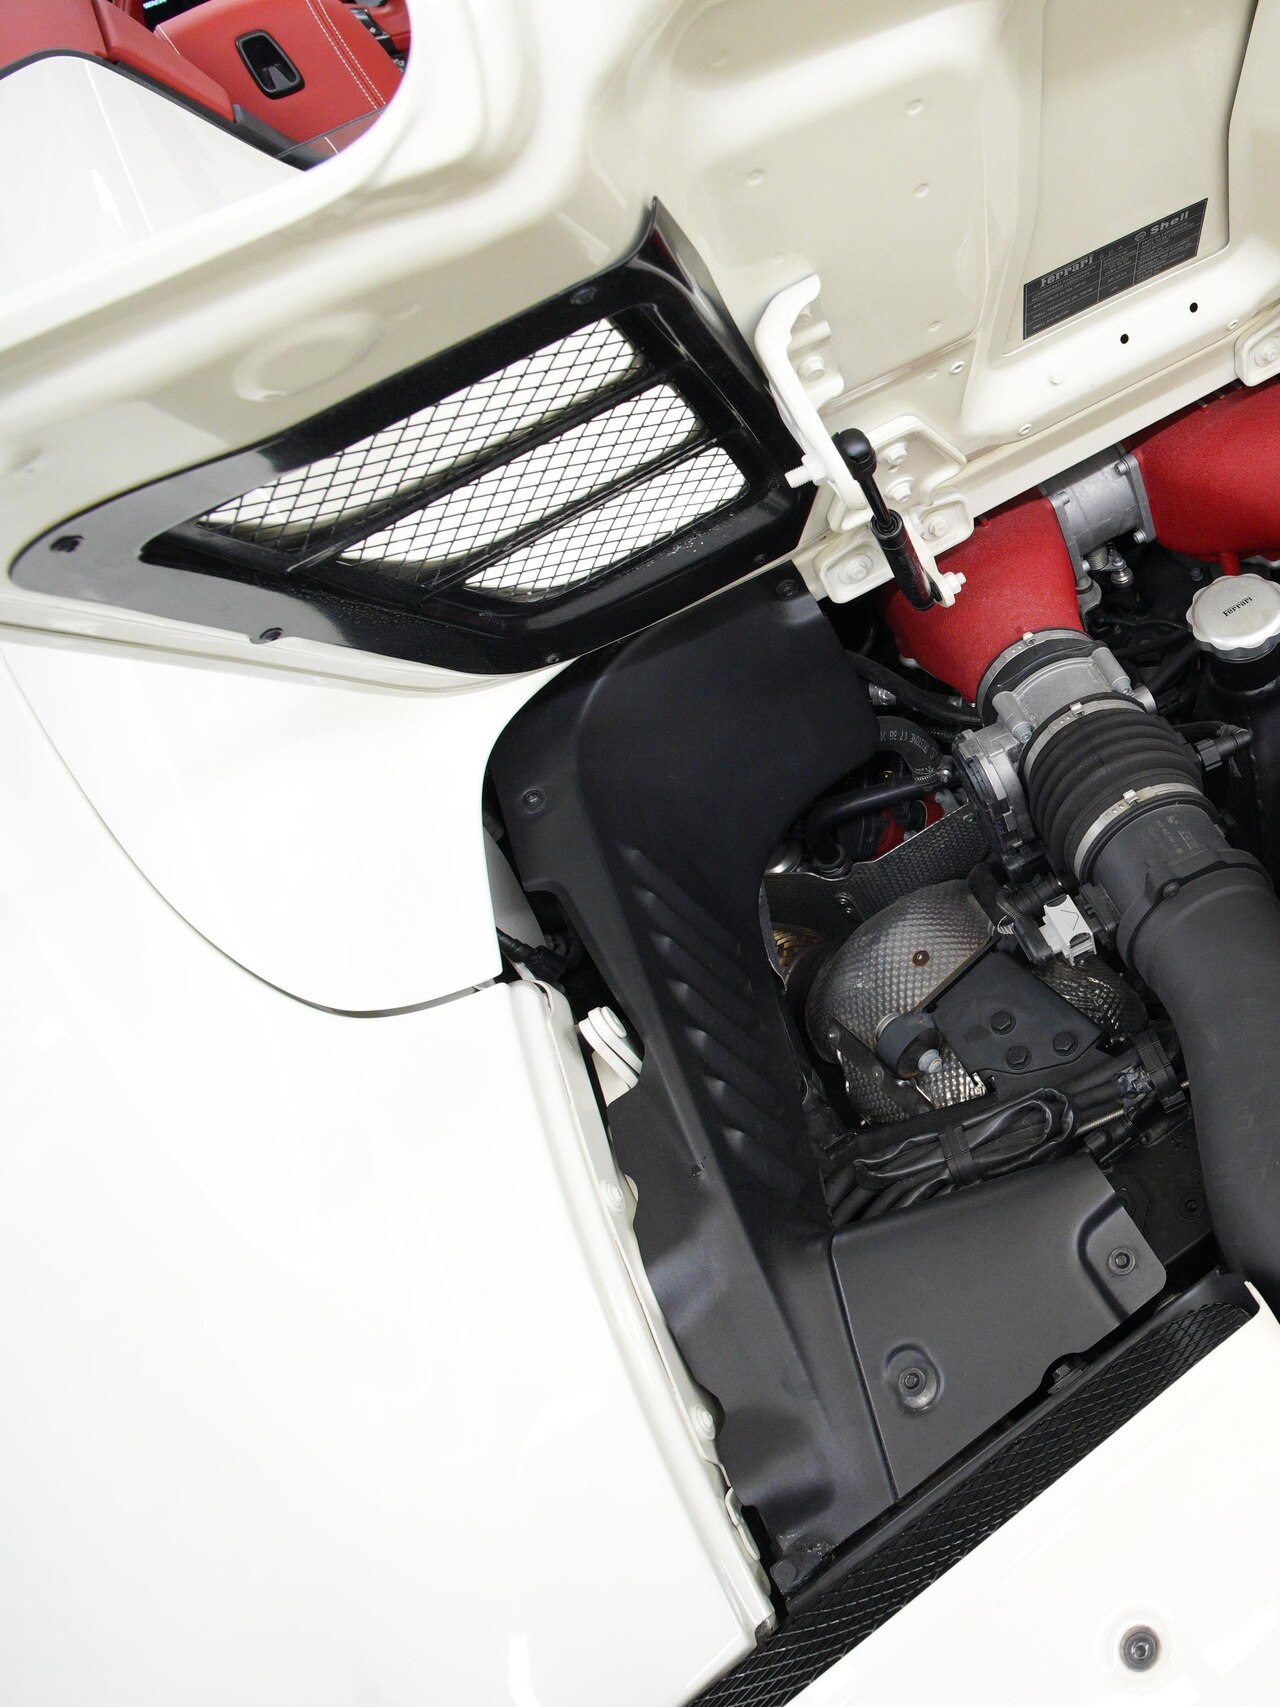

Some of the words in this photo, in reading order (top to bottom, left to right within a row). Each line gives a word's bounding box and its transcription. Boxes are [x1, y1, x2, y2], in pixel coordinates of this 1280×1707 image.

[1150, 210, 1190, 235] Shell
[1040, 255, 1094, 288] Ferrari
[1222, 596, 1253, 617] Ferrari
